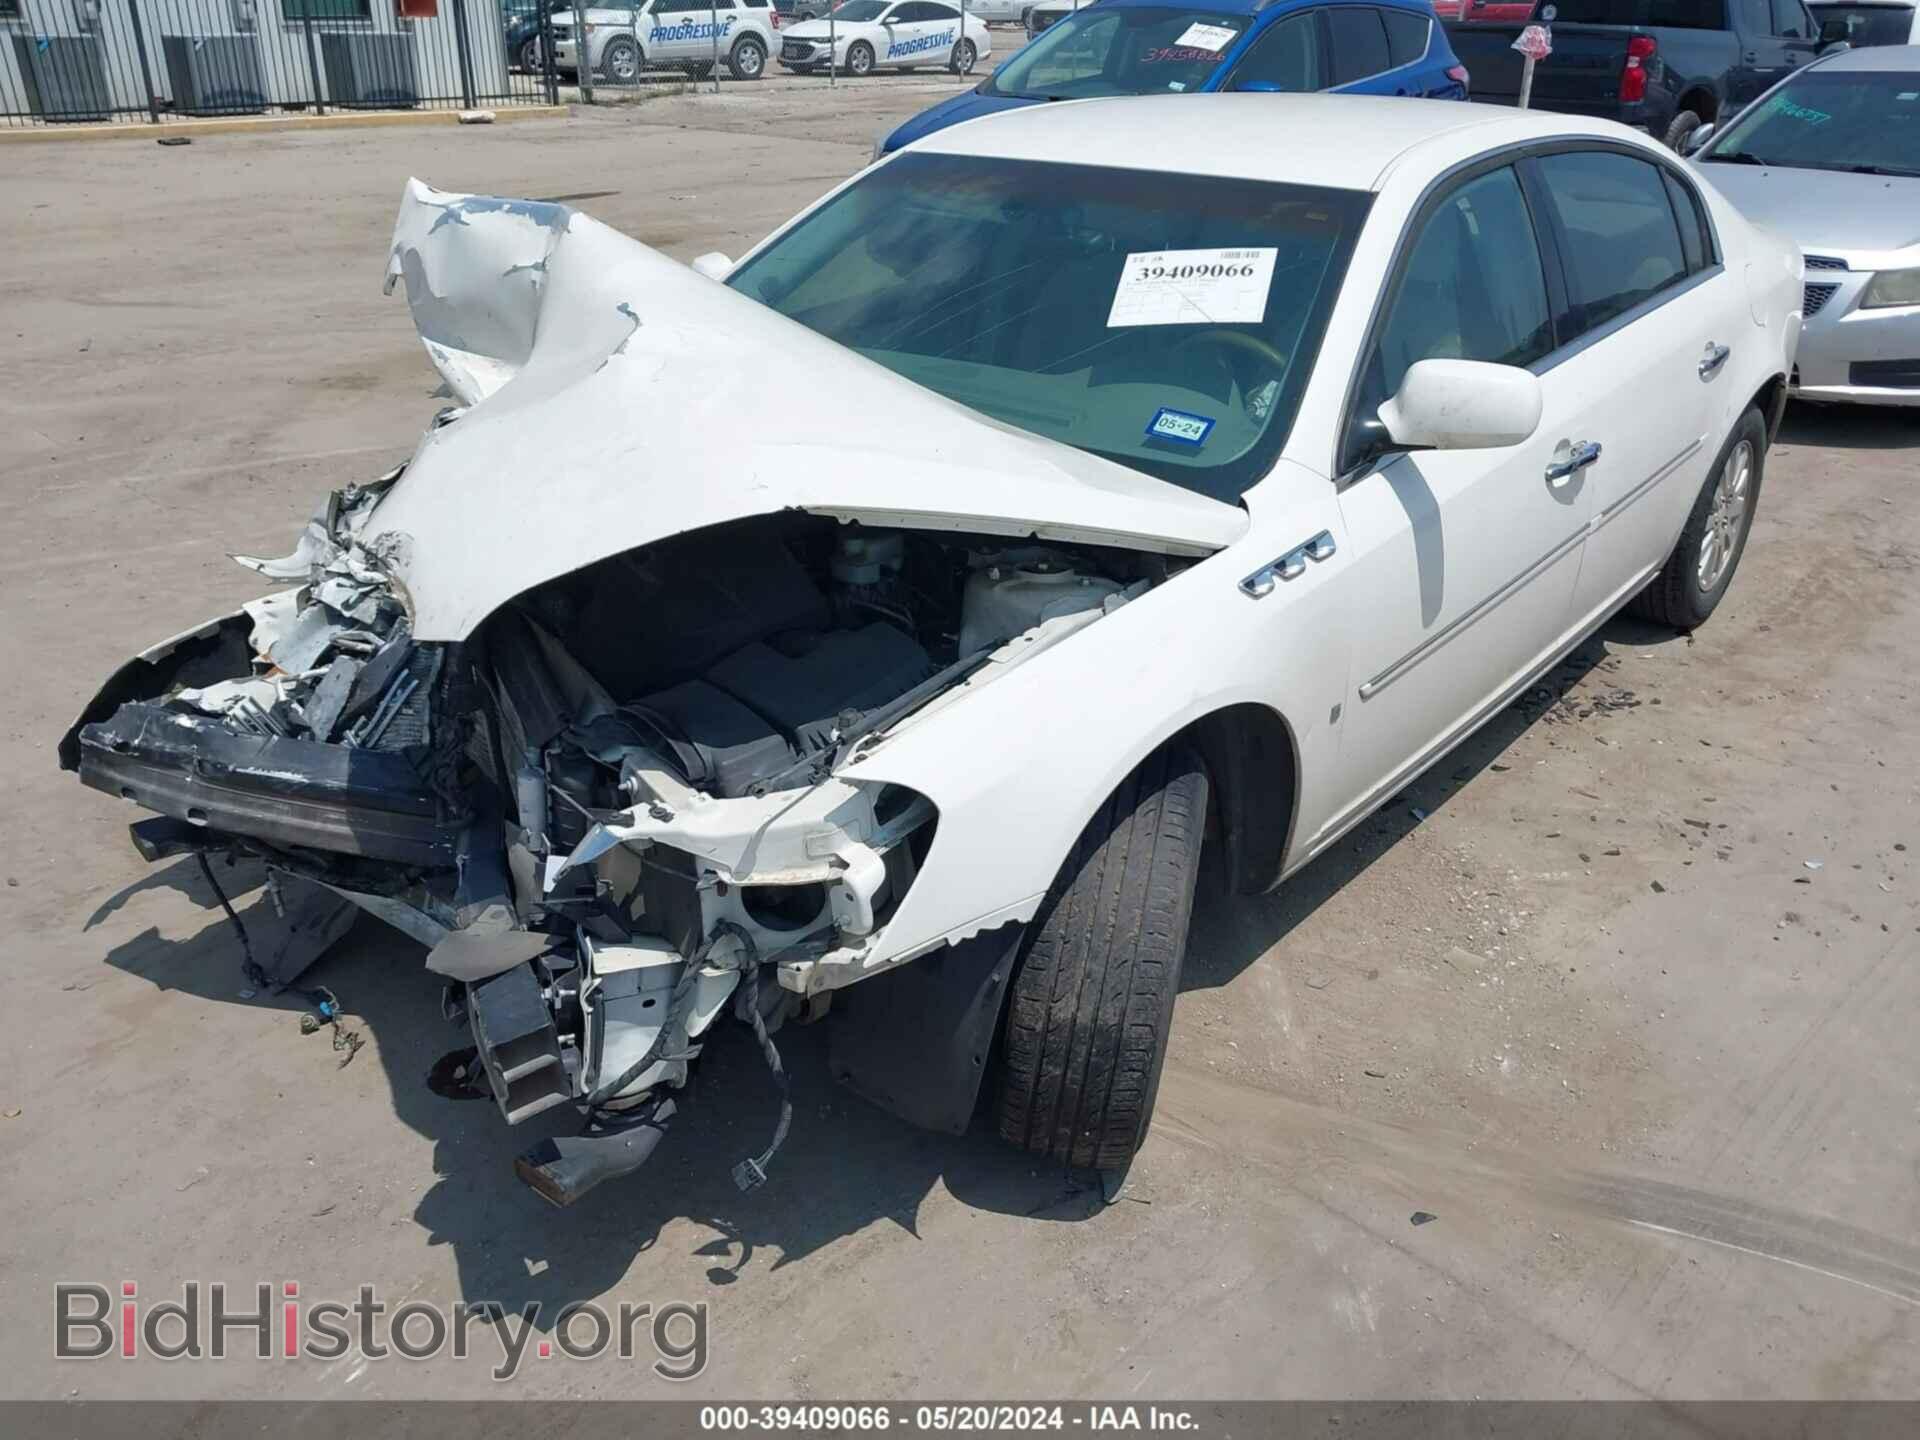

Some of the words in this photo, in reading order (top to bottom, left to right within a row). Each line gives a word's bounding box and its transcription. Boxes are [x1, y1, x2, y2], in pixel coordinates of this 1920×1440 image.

[649, 22, 731, 43] PROGRESSIVE
[887, 30, 955, 59] PROGRESSIVE
[1135, 263, 1254, 281] 39409066
[1158, 417, 1202, 436] 05-24
